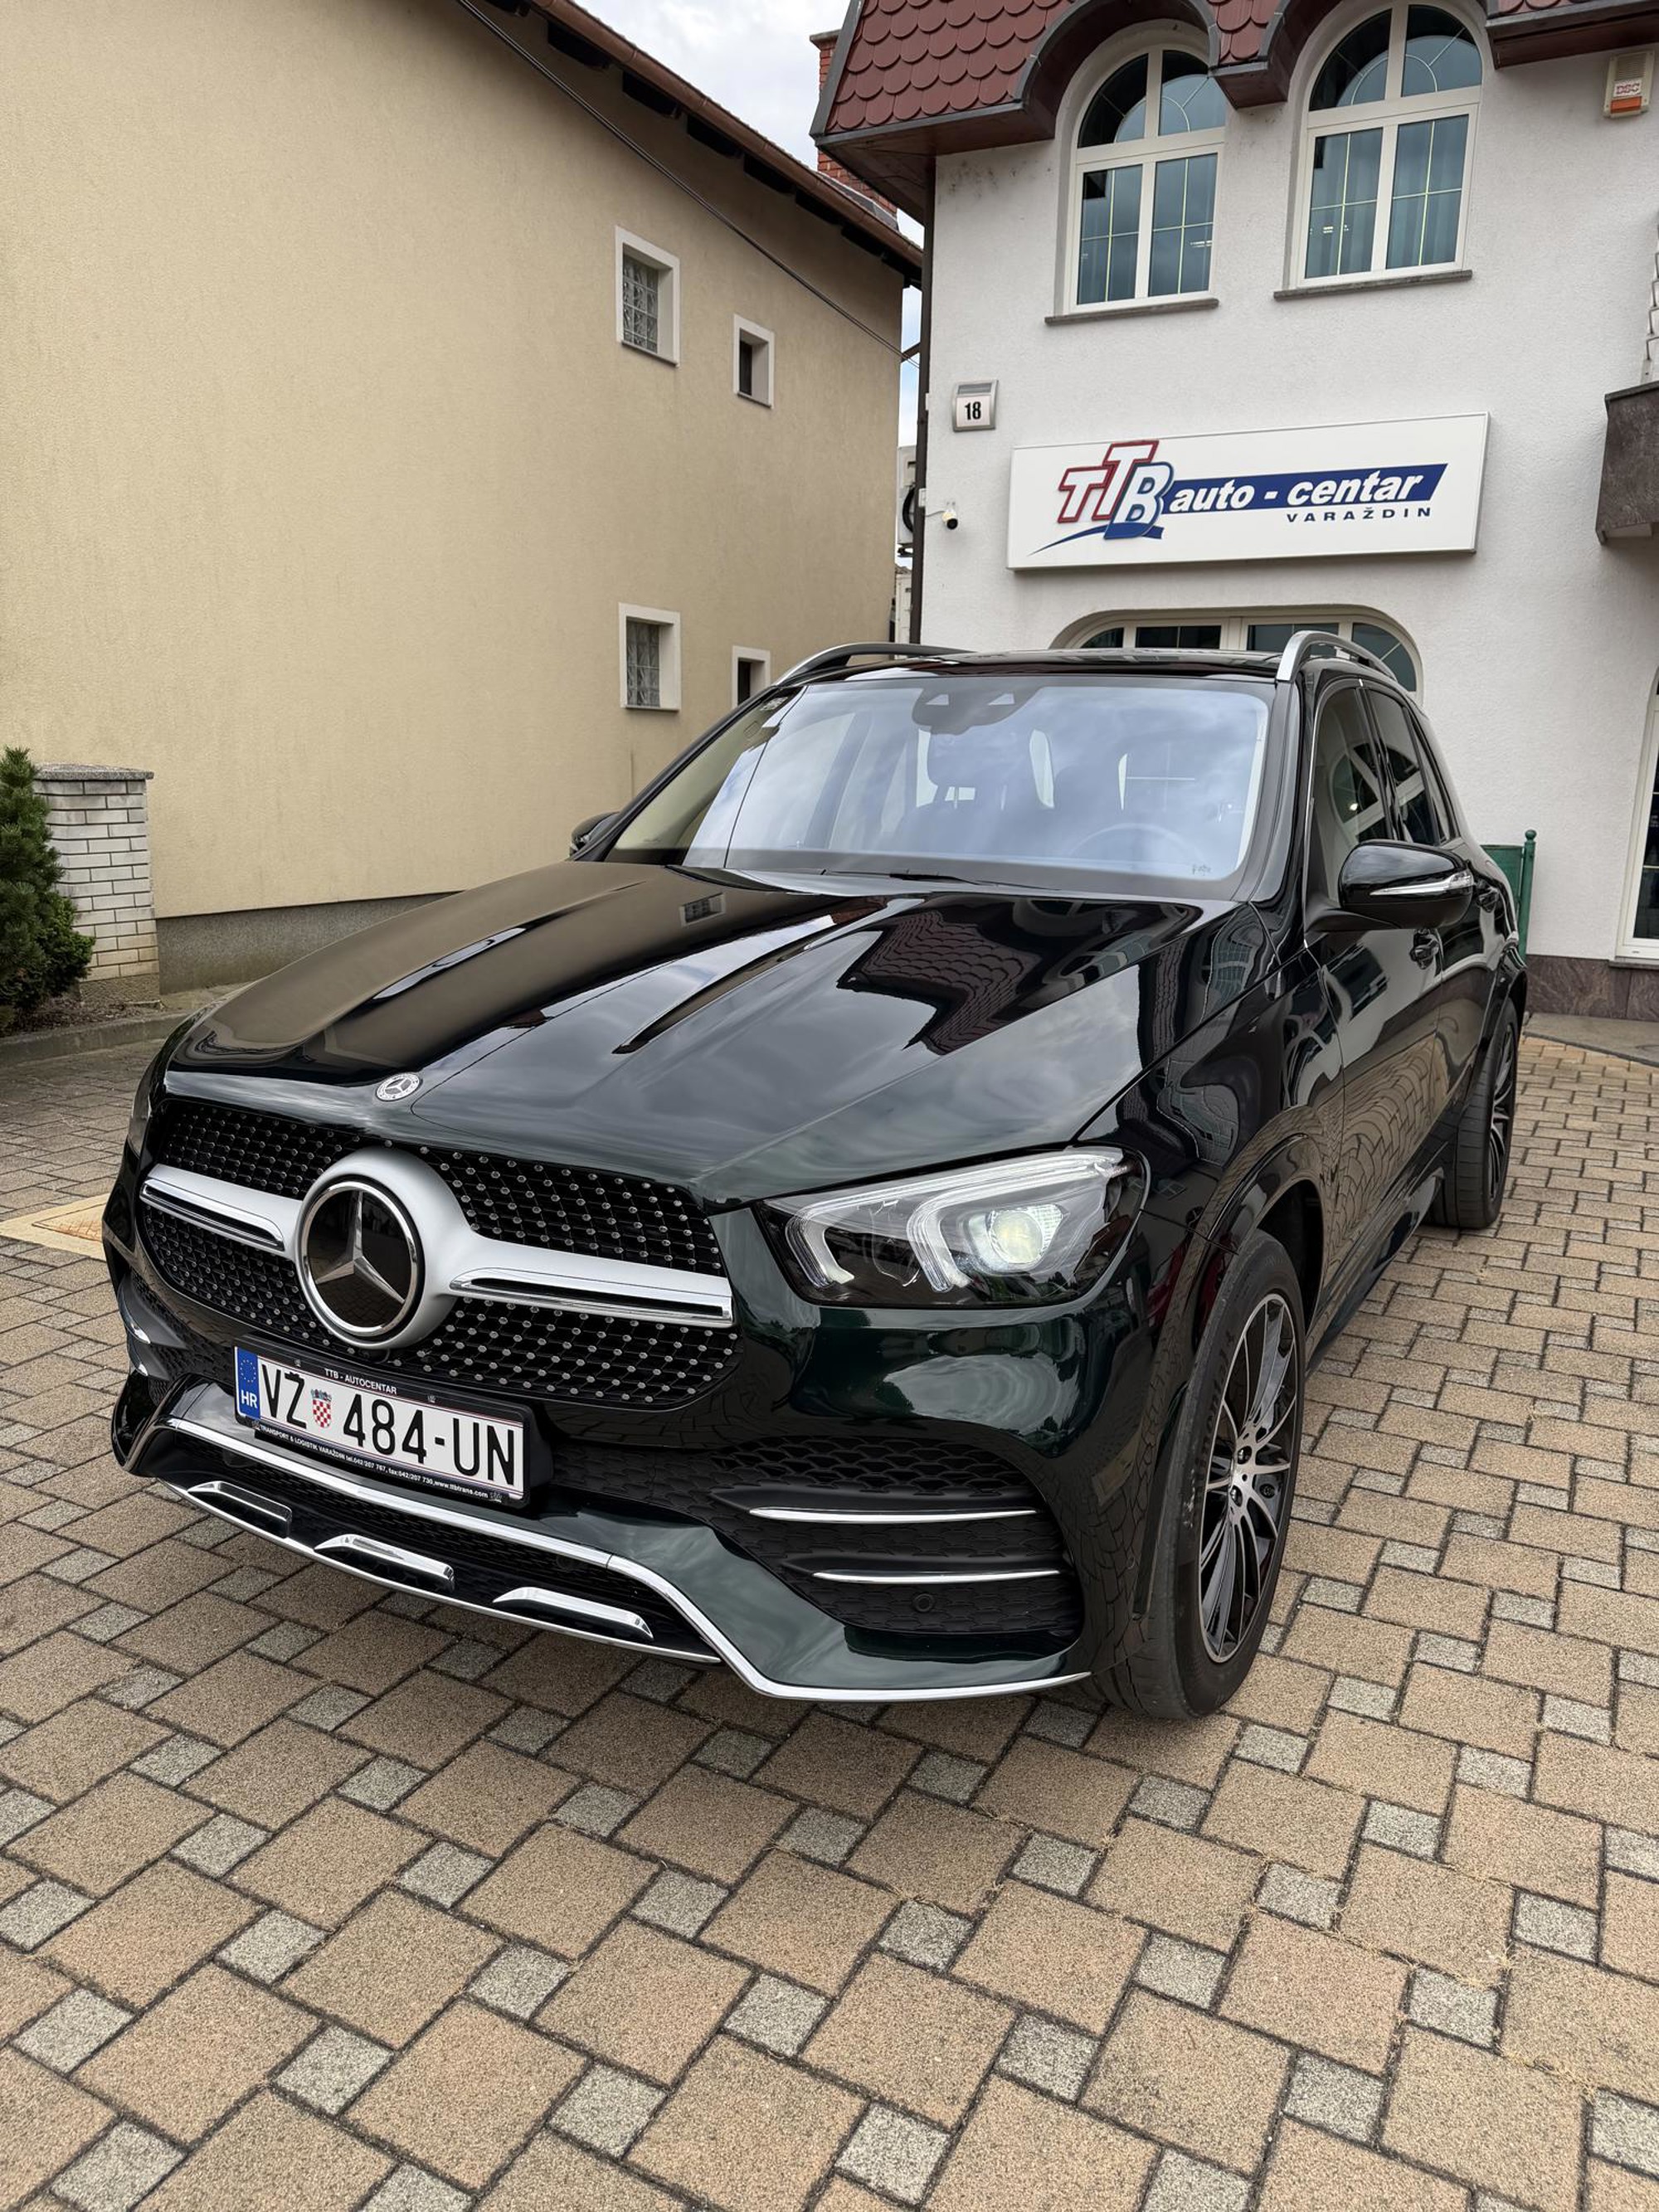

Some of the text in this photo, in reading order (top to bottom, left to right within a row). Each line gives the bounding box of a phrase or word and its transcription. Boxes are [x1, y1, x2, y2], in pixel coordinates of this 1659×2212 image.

[964, 401, 982, 421] 18
[1057, 440, 1175, 539] TTB
[1169, 479, 1256, 513] auto
[1286, 469, 1424, 506] centar
[1287, 507, 1432, 523] VARAŽDIN
[324, 1368, 339, 1379] TTB
[344, 1374, 397, 1395] AUTOCENTAR
[241, 1388, 258, 1409] HR
[260, 1424, 289, 1441] TRANSPORT
[343, 1393, 515, 1487] 484-UN
